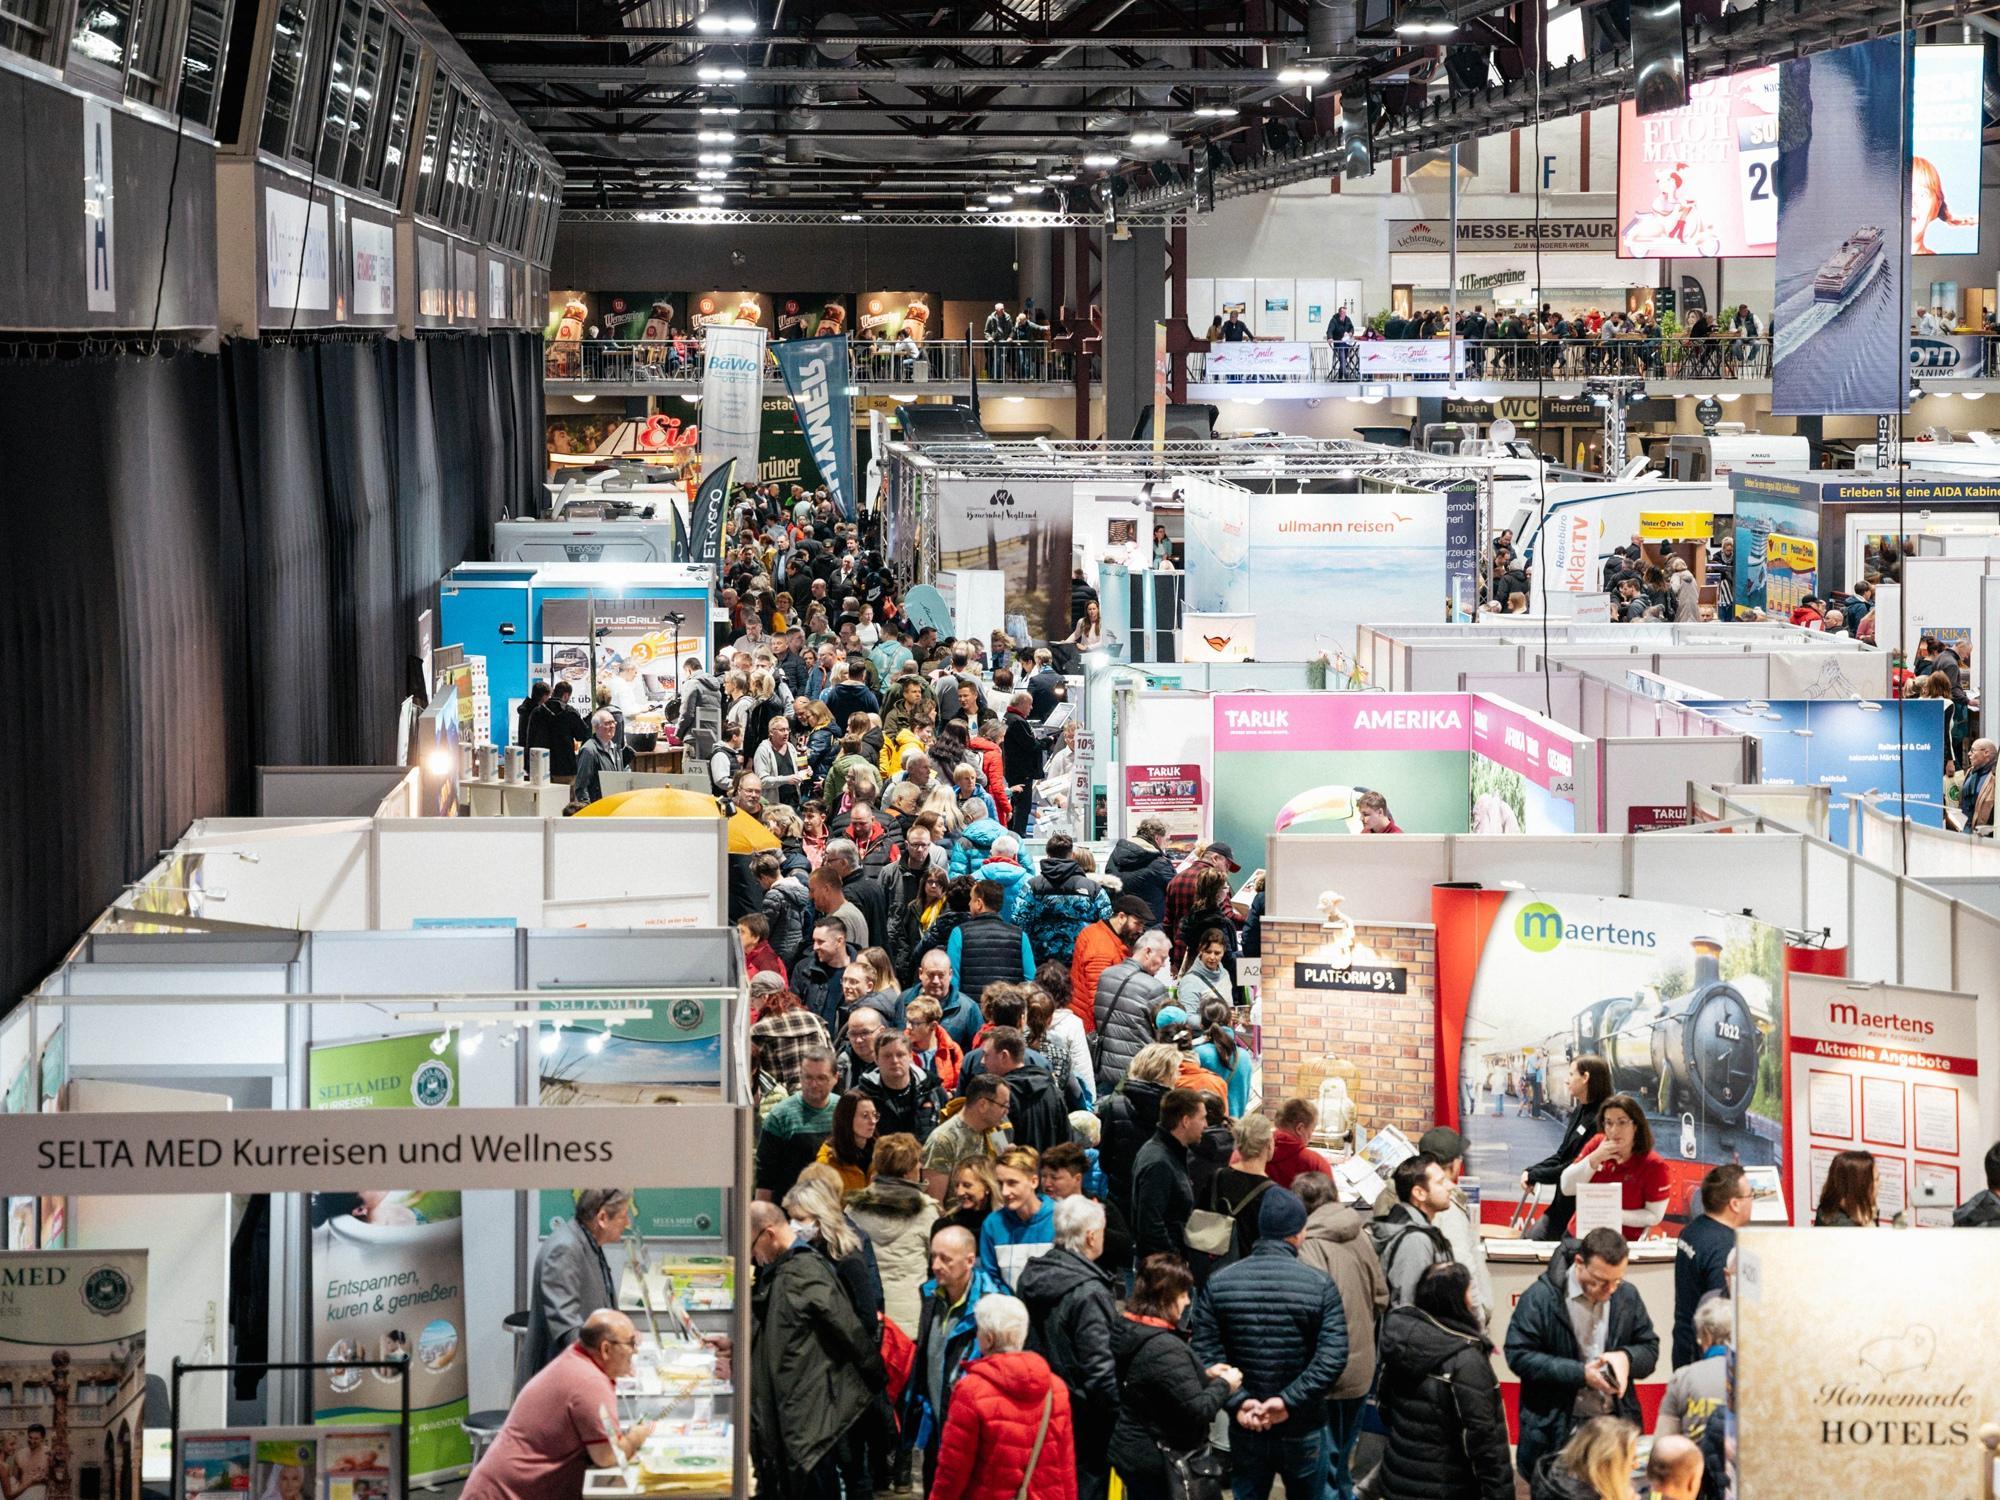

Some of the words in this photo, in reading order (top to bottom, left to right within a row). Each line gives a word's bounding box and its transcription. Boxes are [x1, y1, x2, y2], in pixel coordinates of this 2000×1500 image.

[1543, 155, 1557, 189] F
[1460, 268, 1527, 290] Wernesgrüner
[708, 356, 758, 373] BäWo
[1910, 346, 1957, 368] orn
[1911, 368, 1954, 377] VANING
[1446, 402, 1488, 414] Damen
[1500, 399, 1538, 417] WC
[1550, 402, 1590, 414] Herren
[639, 413, 698, 449] Eis
[1839, 486, 1883, 498] Erleben
[1886, 486, 1901, 498] Sie
[1905, 486, 1931, 498] eine
[1932, 486, 1962, 498] AIDA
[1278, 520, 1343, 533] ullmann
[1347, 520, 1395, 533] reisen
[1450, 535, 1468, 545] 100
[1556, 514, 1568, 569] Reisebüro
[1224, 709, 1289, 728] TARUK
[1353, 709, 1463, 730] AMERIKA
[1077, 738, 1095, 751] 10%
[1146, 766, 1181, 777] TARUK
[1076, 776, 1089, 789] 5%
[1555, 782, 1575, 792] A34
[1523, 911, 1657, 949] maertens
[1304, 968, 1371, 985] PLATFORM
[1830, 1002, 1935, 1036] maertens
[1814, 1041, 1876, 1060] Aktuelle
[1879, 1049, 1951, 1071] Angebote
[318, 1081, 363, 1099] SELTA
[366, 1075, 401, 1094] MED
[37, 1139, 134, 1169] SELTA
[145, 1139, 222, 1168] MED
[234, 1138, 387, 1167] Kurreisen
[399, 1134, 462, 1164] und
[471, 1133, 613, 1163] Wellness
[1, 1267, 67, 1287] MED
[326, 1270, 420, 1299] Entspannen,
[326, 1299, 369, 1322] kuren
[373, 1294, 385, 1312] &
[388, 1283, 458, 1314] genießen
[1813, 1383, 1973, 1408] Homemade
[1820, 1419, 1970, 1446] HOTELS
